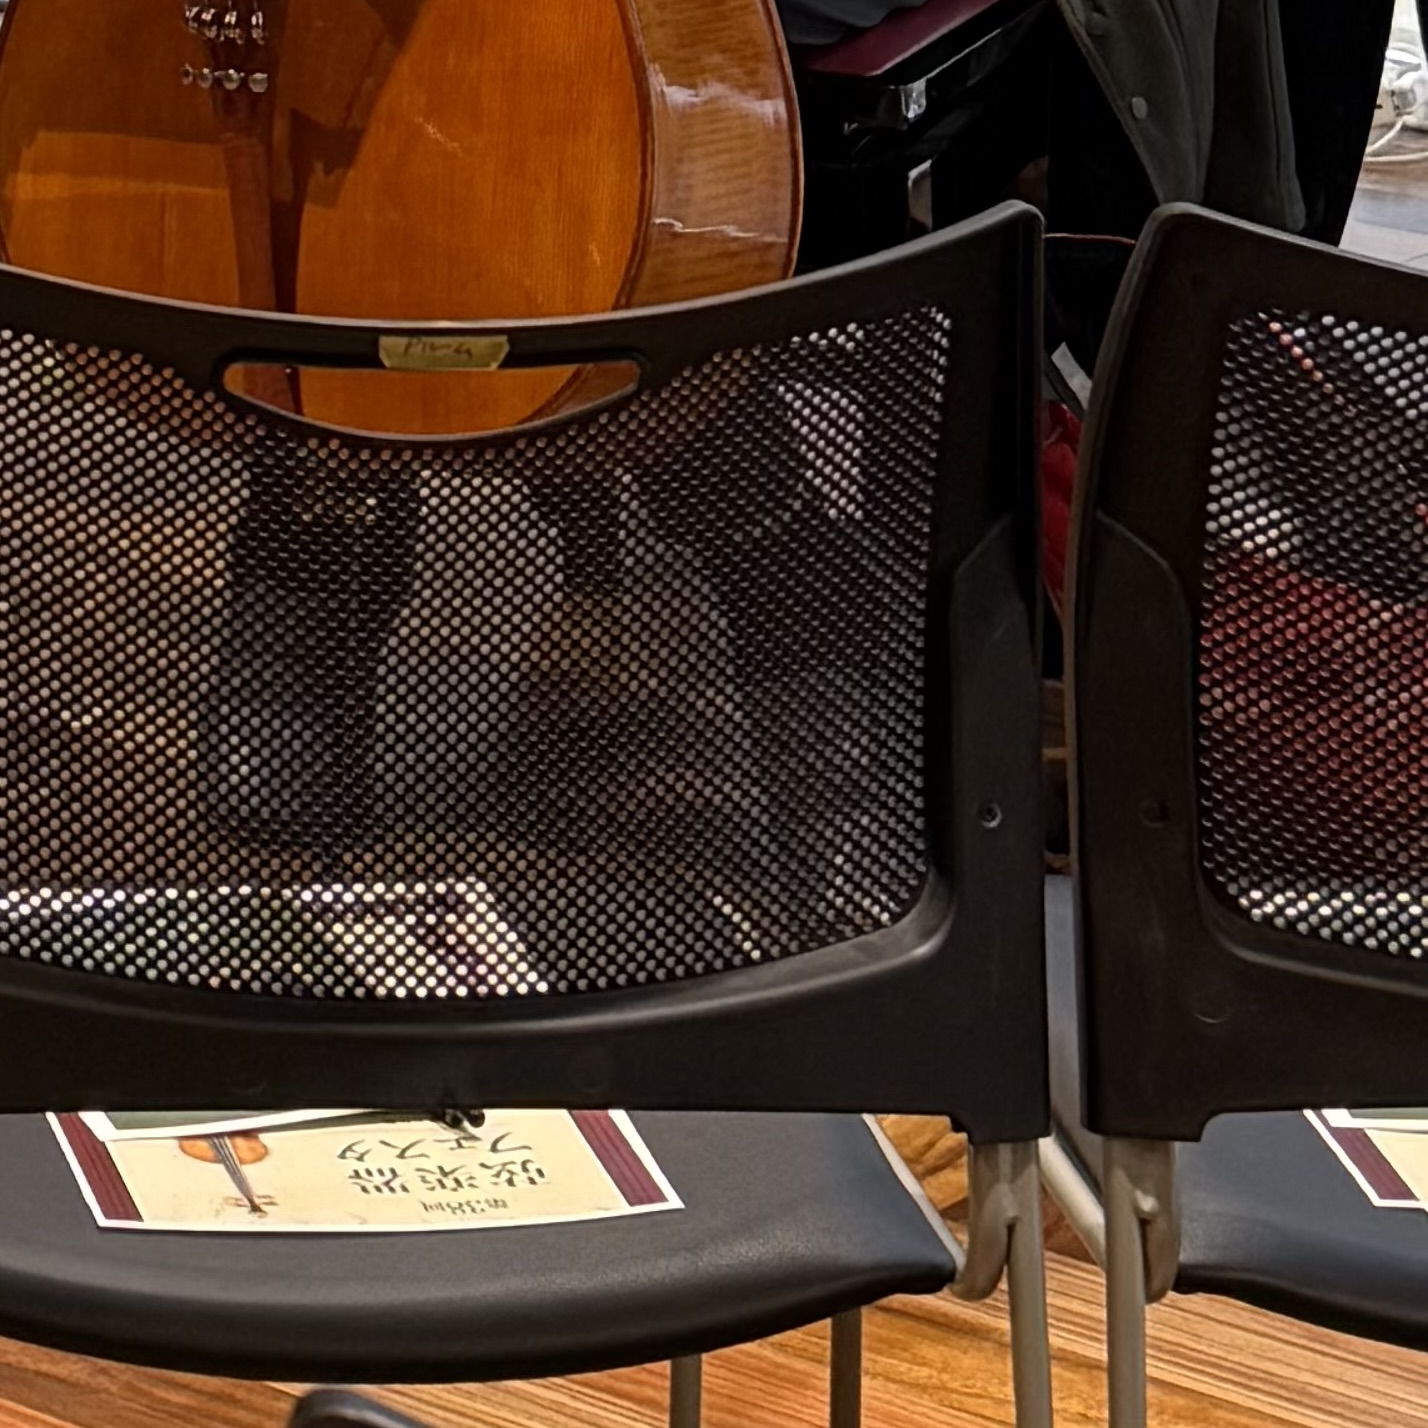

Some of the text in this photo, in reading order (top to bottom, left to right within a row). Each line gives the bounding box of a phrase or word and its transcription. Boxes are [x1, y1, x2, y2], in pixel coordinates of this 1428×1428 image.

[337, 1132, 533, 1162] フェスタ
[347, 1158, 546, 1195] 弦楽器
